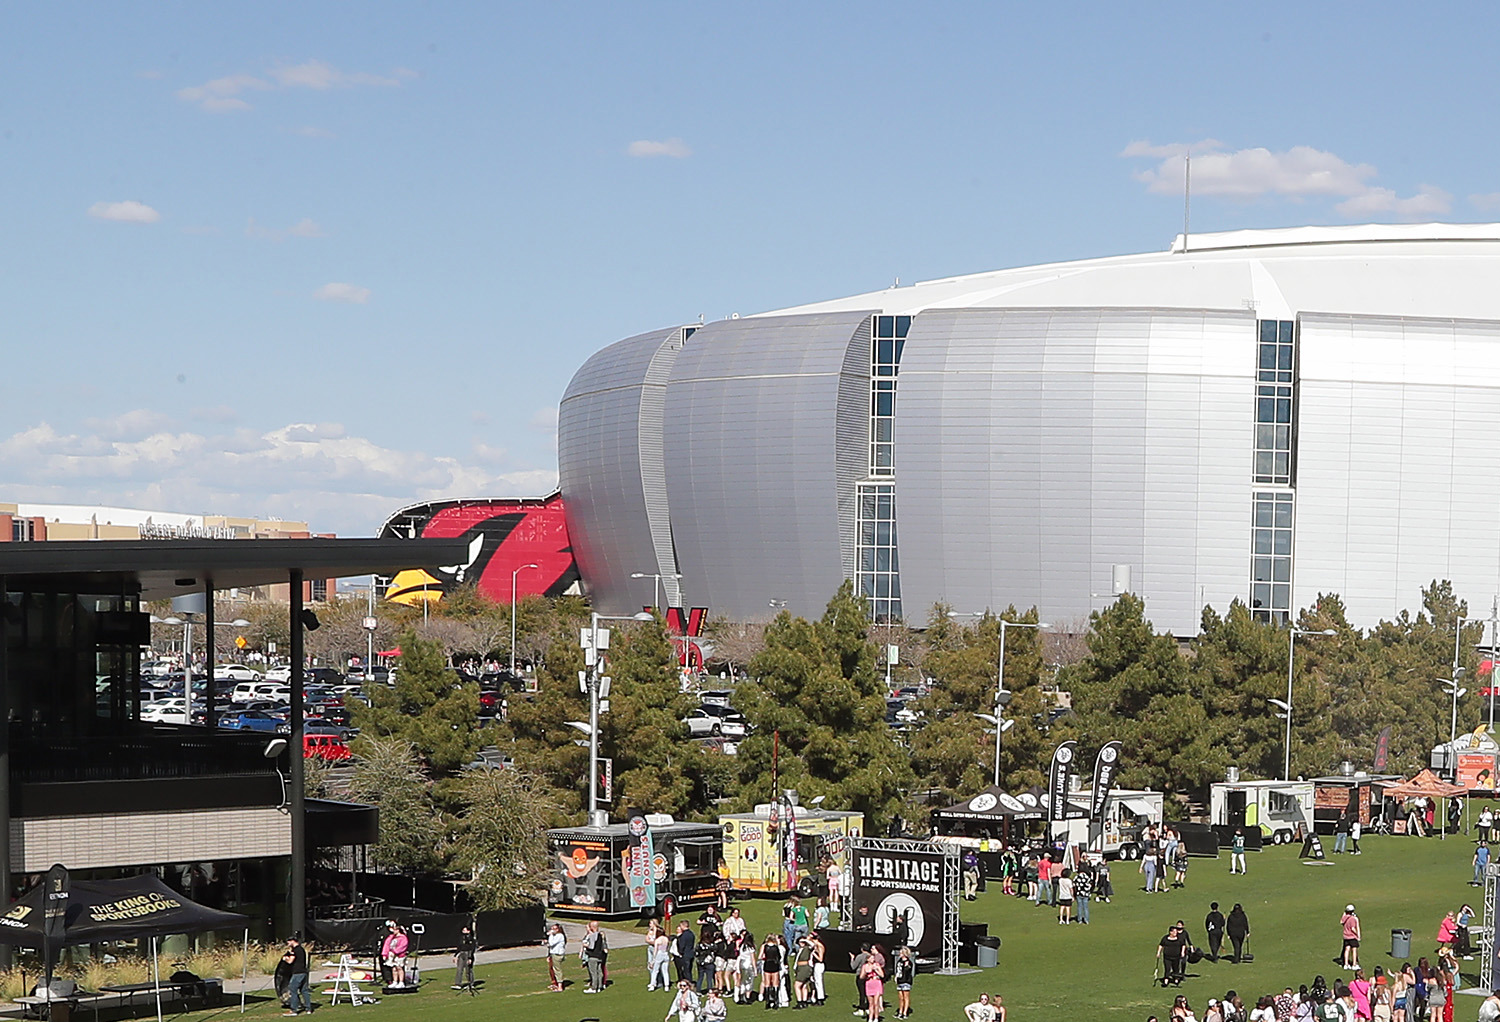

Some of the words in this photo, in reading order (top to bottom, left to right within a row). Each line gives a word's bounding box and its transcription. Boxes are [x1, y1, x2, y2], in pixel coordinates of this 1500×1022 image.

[1056, 764, 1067, 794] LUKE'S
[1100, 765, 1112, 785] BBQ
[1054, 794, 1064, 820] SAUCY
[740, 832, 762, 842] GOOD
[631, 846, 642, 877] MINI
[641, 835, 651, 886] DONUTS
[858, 857, 940, 883] HERITAGE
[860, 879, 871, 888] AT
[871, 880, 921, 892] SPORTSMAN'S
[921, 883, 940, 893] PARK
[90, 903, 116, 915] THE
[114, 895, 149, 911] KING
[91, 899, 181, 922] SPORTSBOOKS
